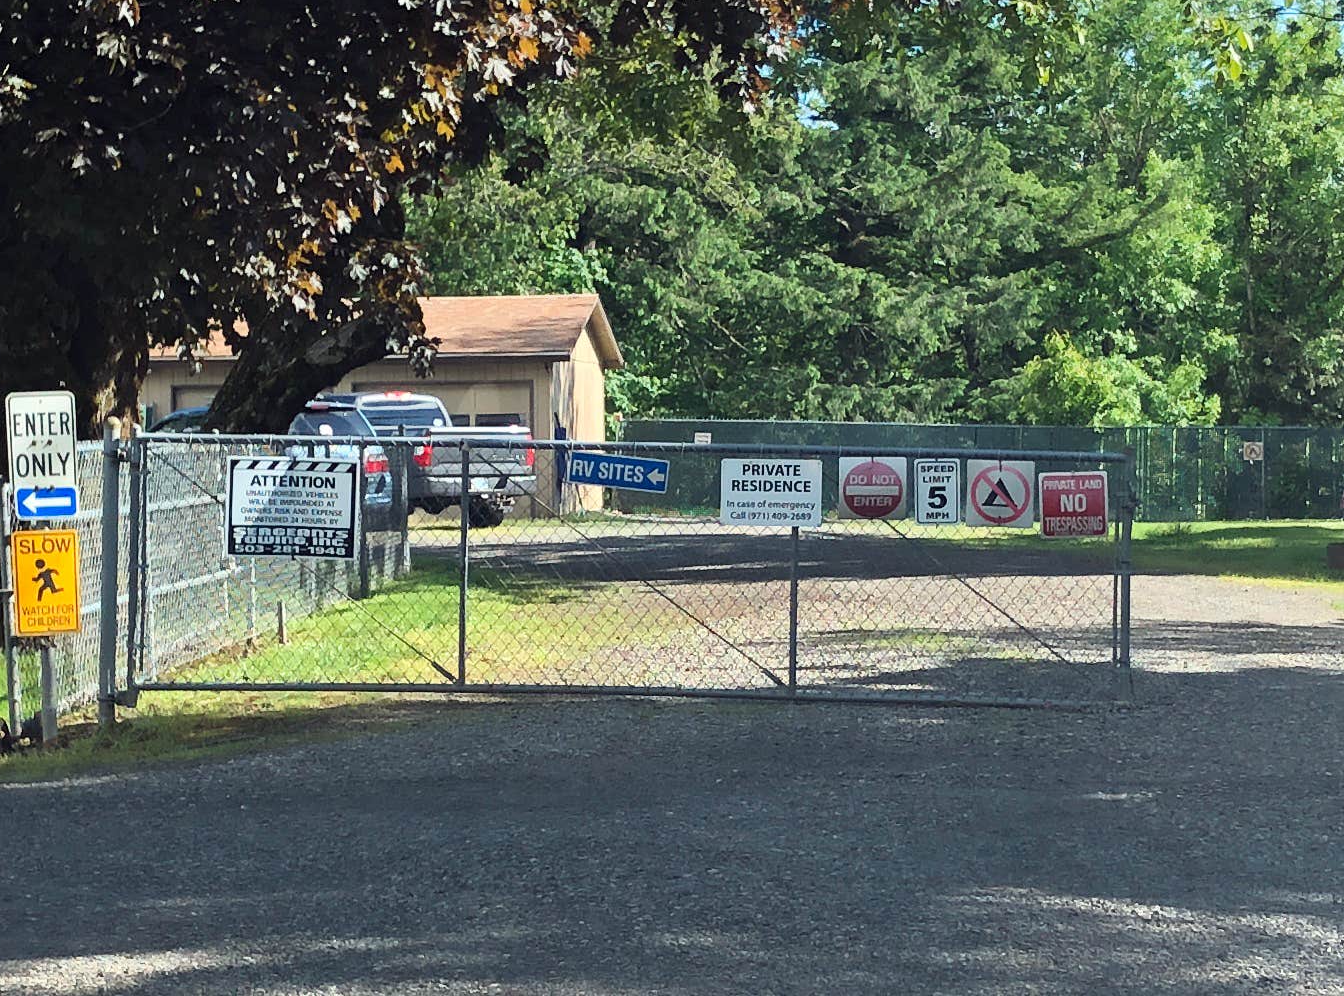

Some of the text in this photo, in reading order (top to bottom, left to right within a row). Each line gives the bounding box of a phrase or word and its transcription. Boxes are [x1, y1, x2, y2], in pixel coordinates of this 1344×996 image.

[13, 412, 70, 437] ENTER
[16, 452, 70, 477] ONLY
[742, 464, 801, 476] PRIVATE
[920, 465, 954, 473] SPEED
[572, 460, 644, 483] RV SITES
[250, 475, 336, 488] ATTENTION
[850, 475, 896, 484] DO NOT
[1043, 479, 1102, 490] PRIVATE LAND
[731, 480, 811, 492] RESIDENCE
[306, 491, 338, 499] VEHICLES
[853, 496, 893, 506] ENTER
[927, 486, 948, 509] 5
[726, 500, 734, 508] In
[757, 500, 767, 508] of
[768, 502, 816, 510] emergency
[1060, 494, 1087, 512] NO
[730, 511, 746, 520] Call
[748, 512, 769, 520] (971)
[1045, 516, 1103, 532] TRESPASSING
[19, 538, 71, 554] SLOW
[235, 544, 346, 555] 503-281-1948
[22, 604, 74, 615] WATCH FOR
[27, 615, 71, 627] CHILDREN
